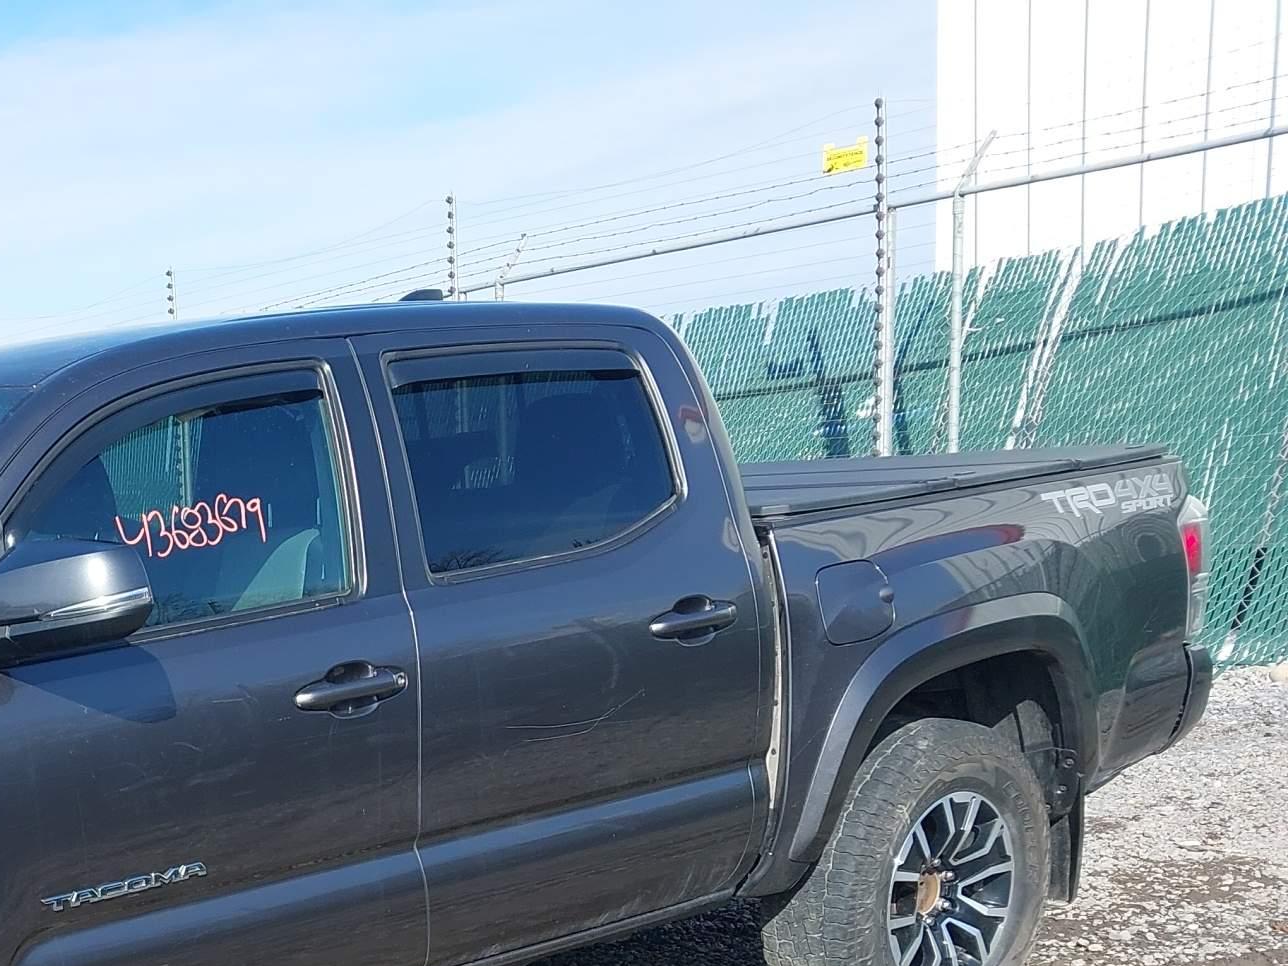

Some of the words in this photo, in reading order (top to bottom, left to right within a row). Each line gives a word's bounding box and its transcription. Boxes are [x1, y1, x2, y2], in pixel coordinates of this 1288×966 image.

[1040, 483, 1116, 517] TRD
[1121, 494, 1175, 514] SPORT
[115, 493, 267, 557] 43683679
[41, 862, 208, 912] TACOMA
